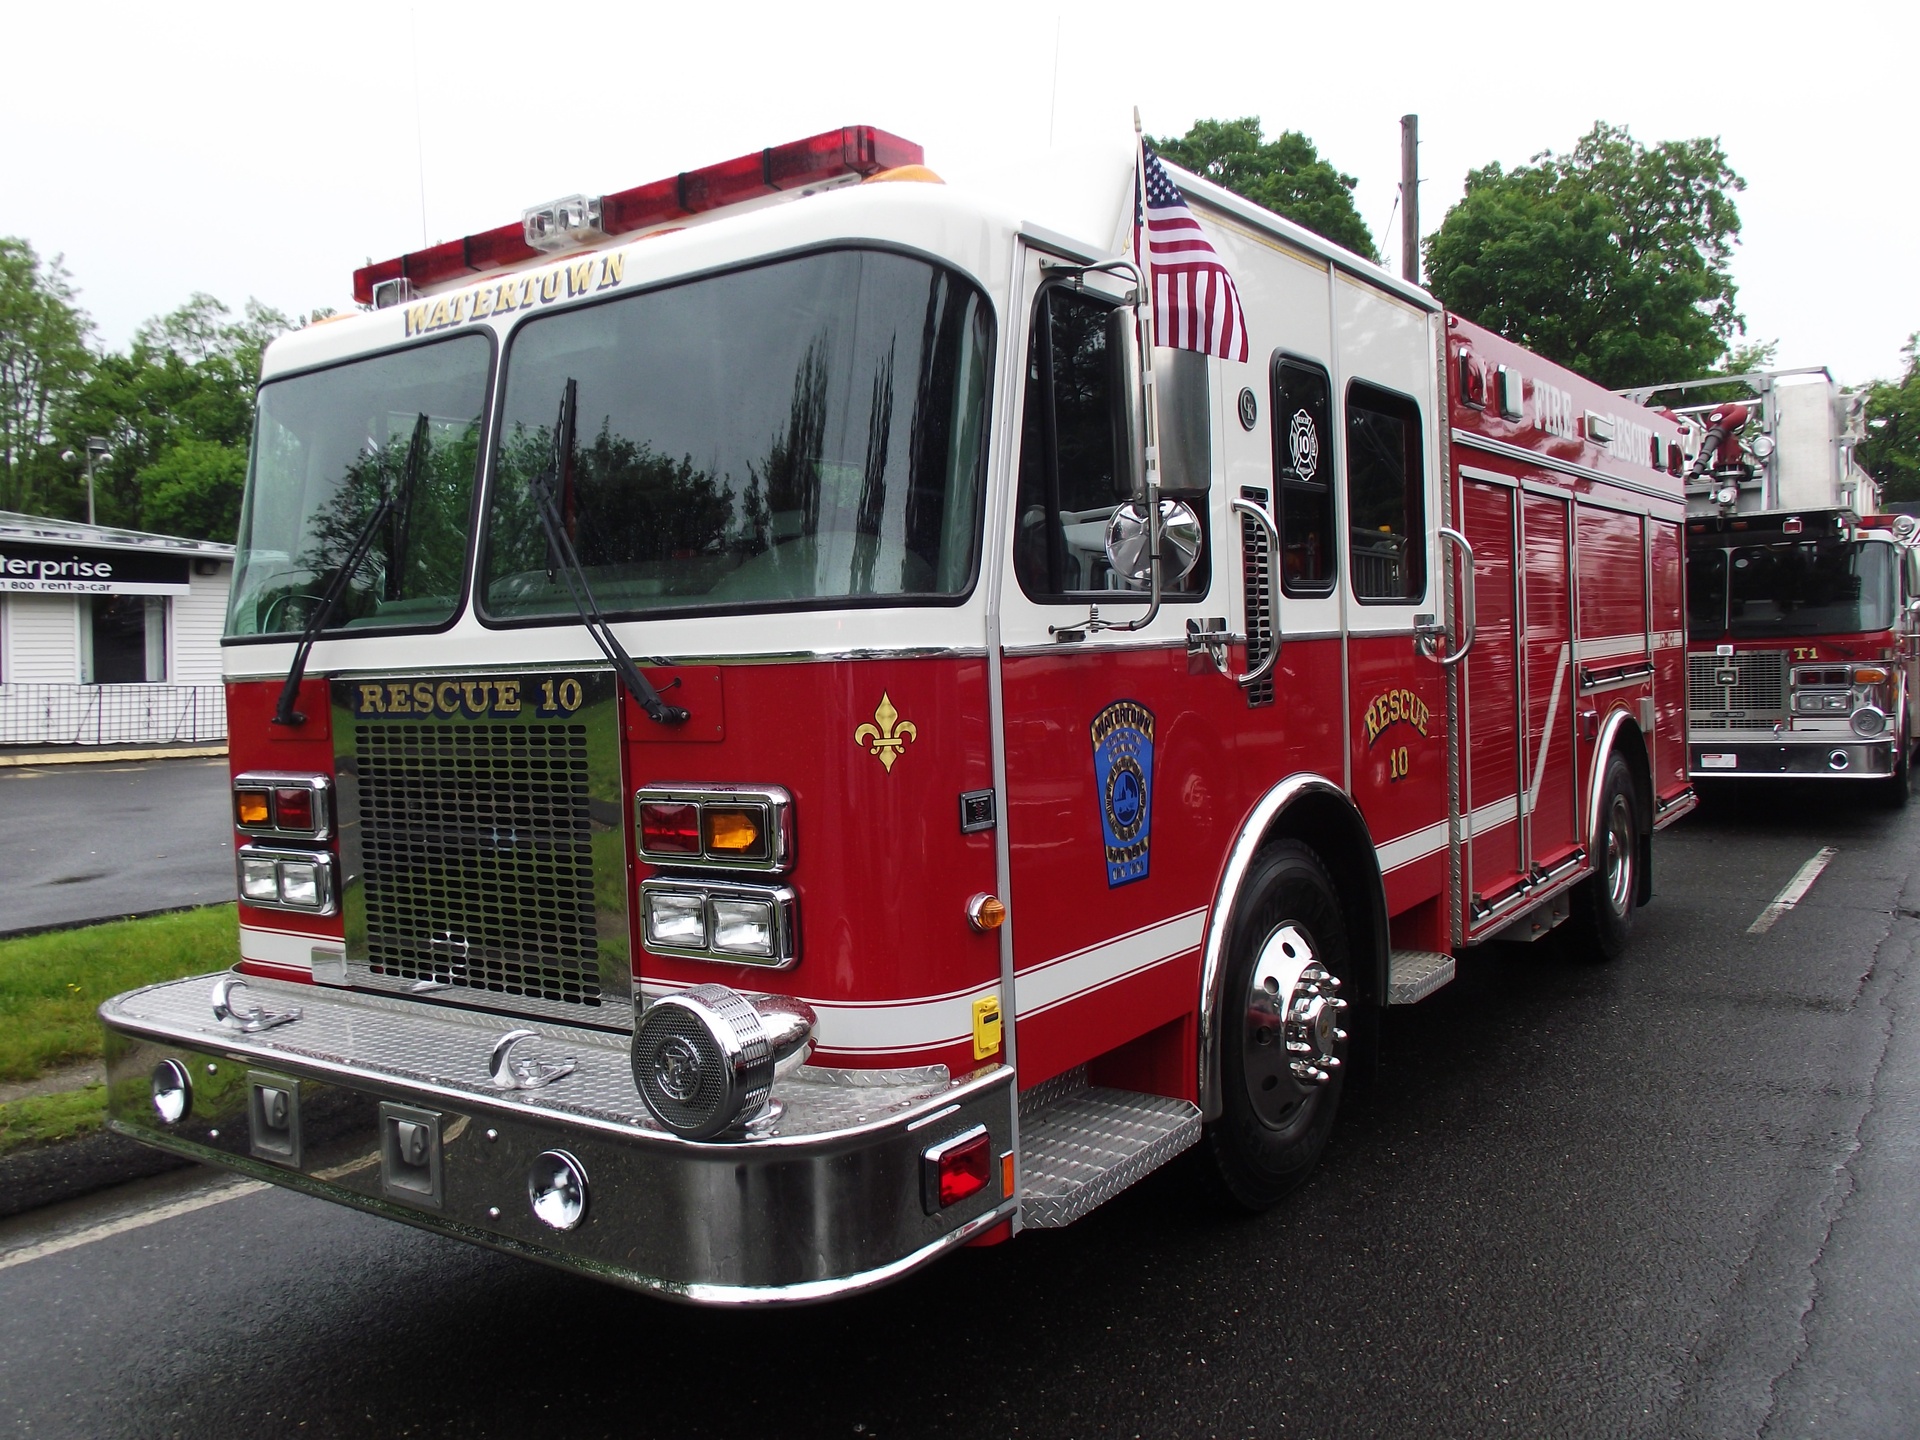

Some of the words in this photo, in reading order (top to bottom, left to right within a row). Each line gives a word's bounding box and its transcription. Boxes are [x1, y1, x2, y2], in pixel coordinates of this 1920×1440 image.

[404, 252, 629, 337] WATERTOWN
[1533, 378, 1573, 441] FIRE
[1299, 435, 1309, 454] 10
[0, 554, 112, 580] terprise
[11, 581, 35, 590] 800
[41, 582, 112, 591] rent-a-car
[1793, 647, 1819, 660] T1
[357, 681, 520, 716] RESCUE
[539, 679, 583, 714] 10
[1095, 708, 1151, 738] WATERTOWN
[1365, 689, 1429, 747] RESCUE
[1390, 746, 1408, 780] 10
